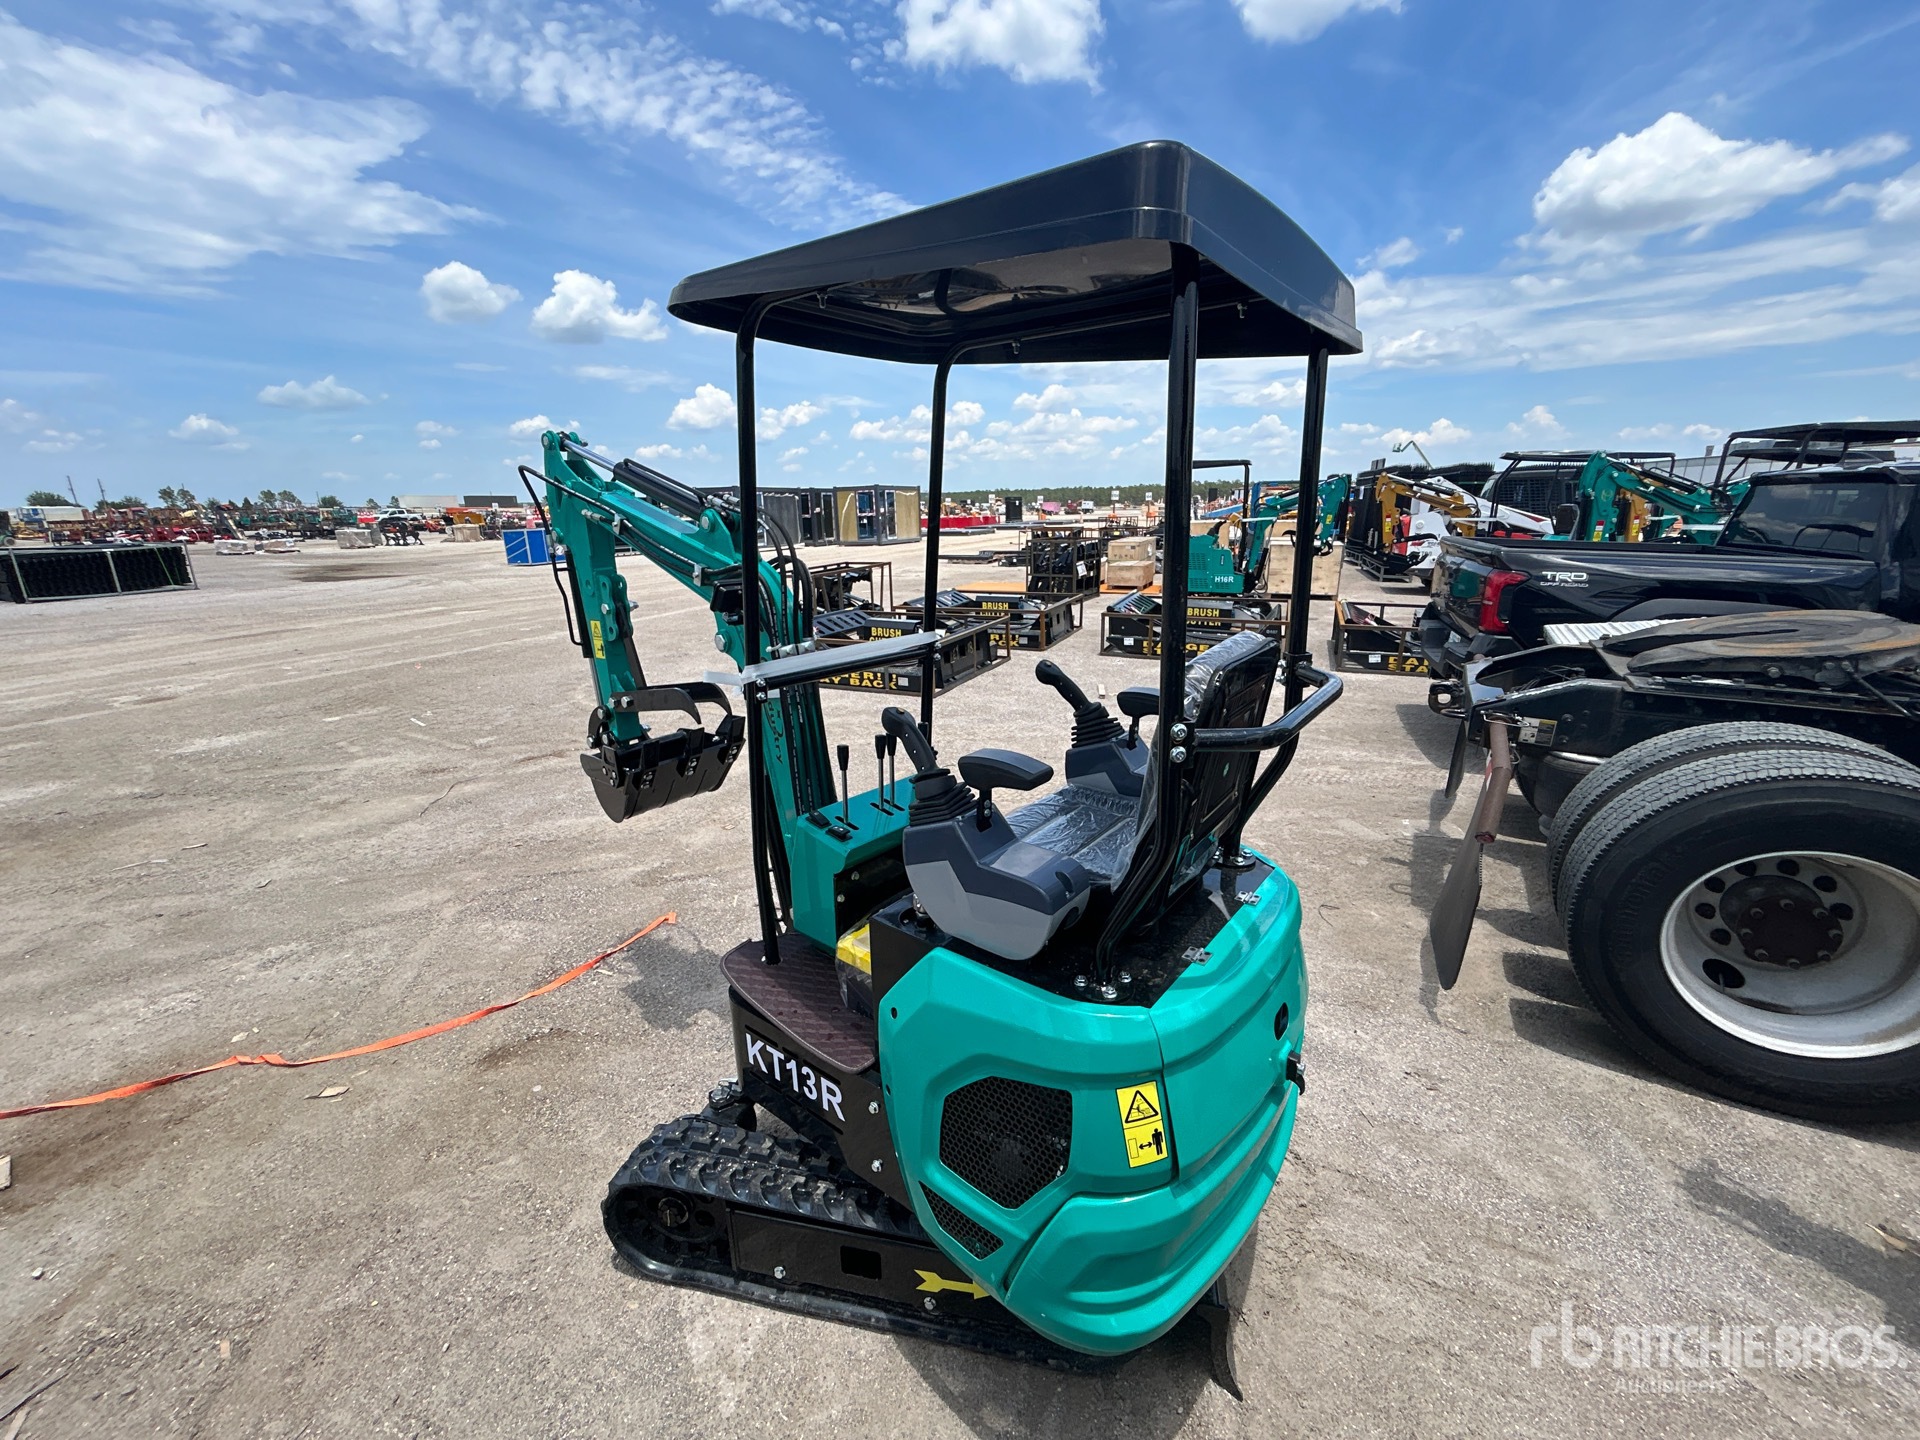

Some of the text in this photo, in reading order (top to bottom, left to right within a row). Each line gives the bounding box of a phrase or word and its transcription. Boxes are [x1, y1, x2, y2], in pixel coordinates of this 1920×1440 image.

[1214, 575, 1234, 583] H16R
[1541, 571, 1588, 582] TRD
[982, 601, 1009, 610] BRUSH
[1187, 607, 1220, 618] BRUSH
[871, 626, 902, 638] BRUSH
[850, 678, 897, 690] BACK
[745, 1032, 846, 1122] KT13R
